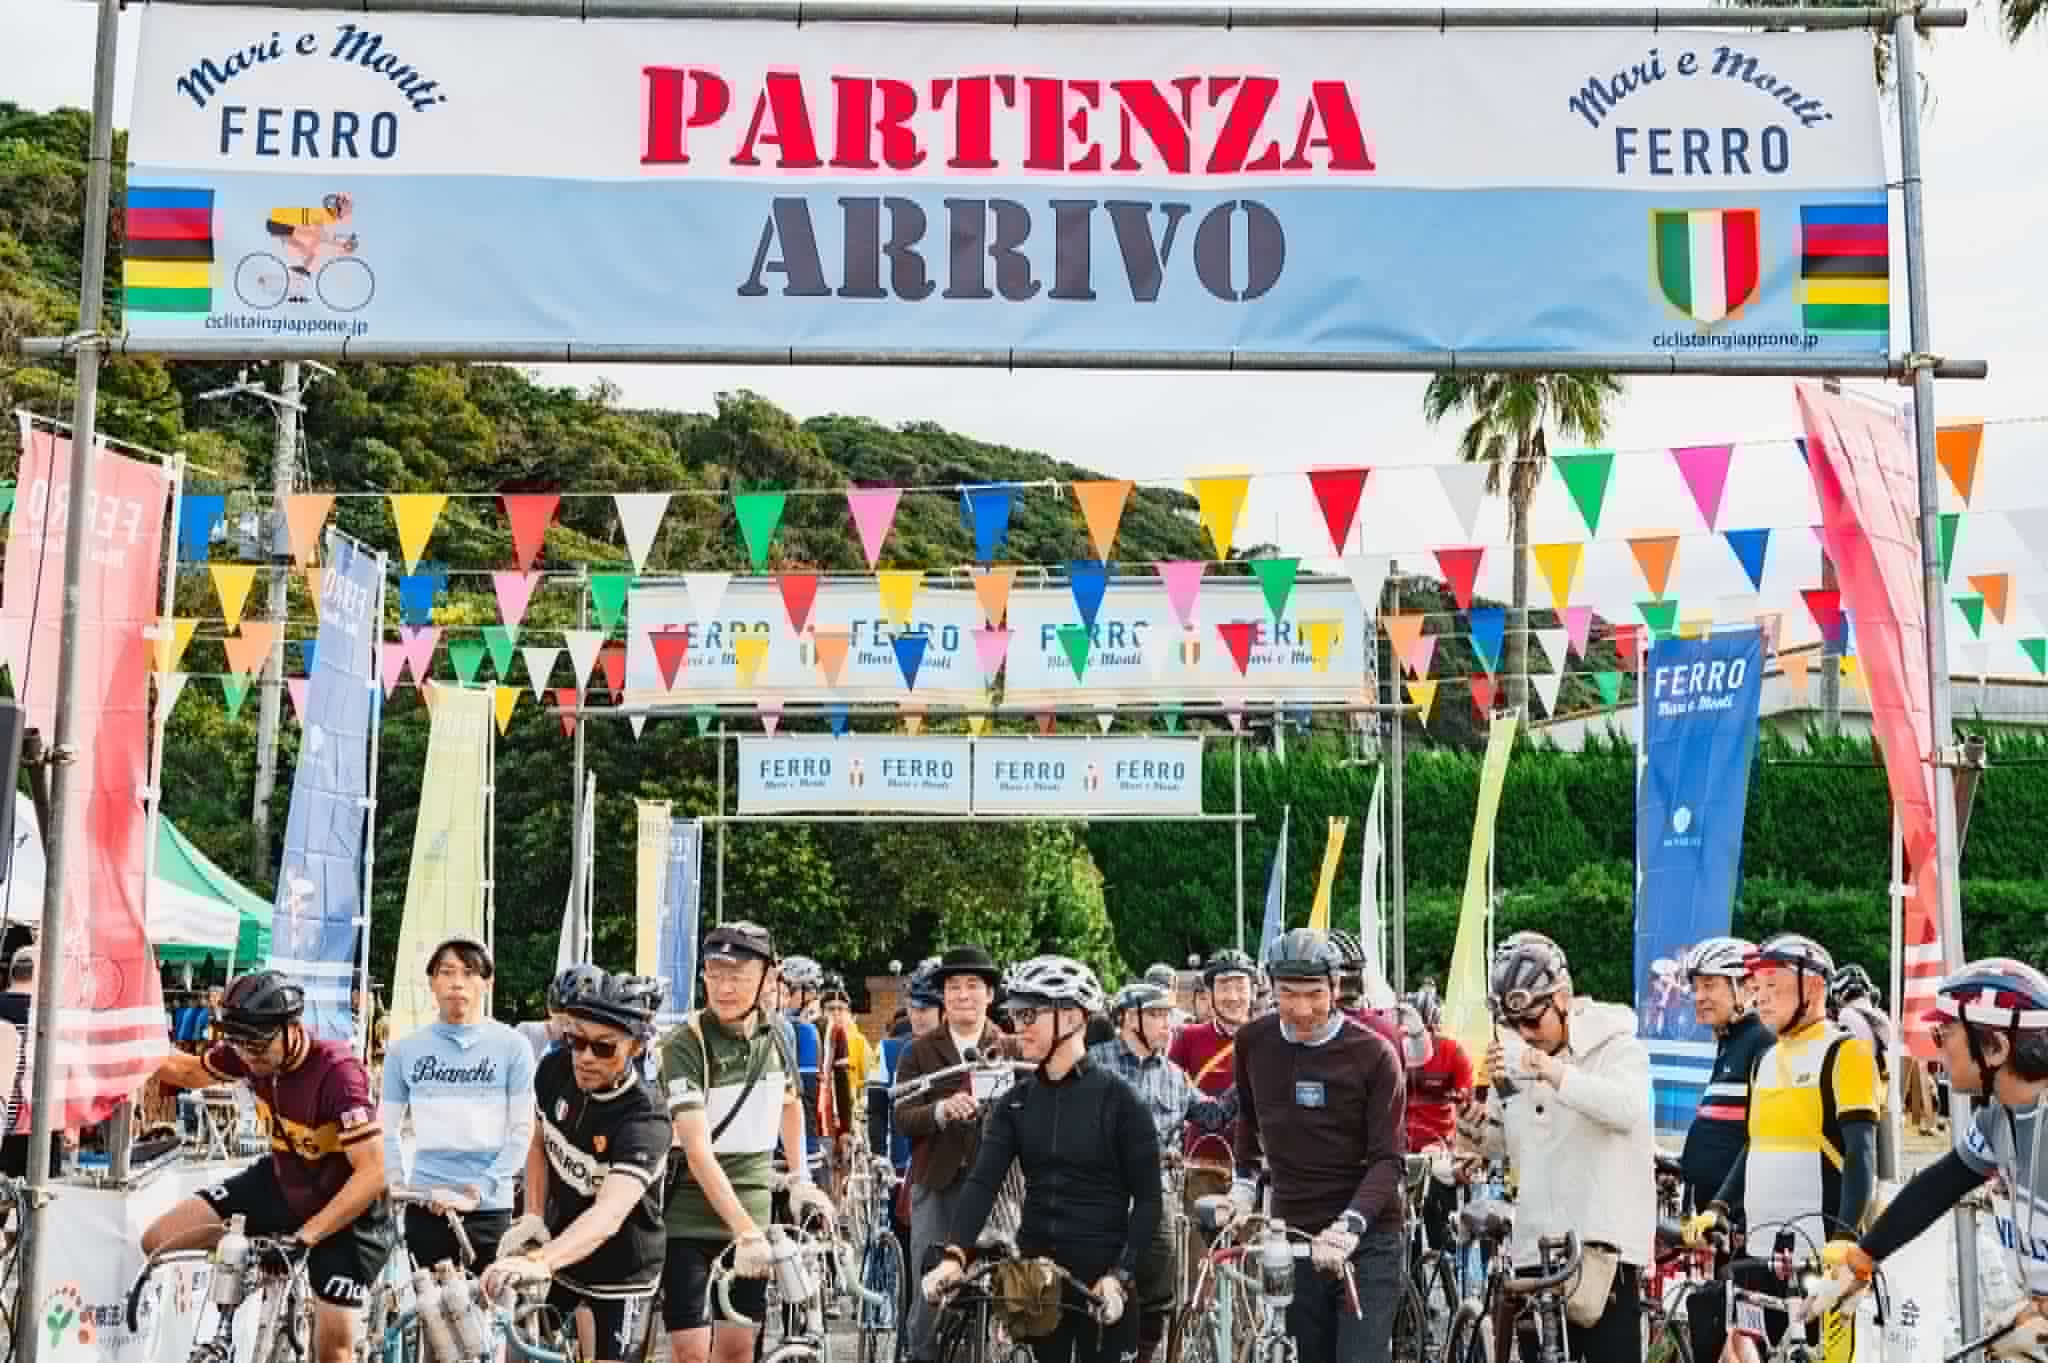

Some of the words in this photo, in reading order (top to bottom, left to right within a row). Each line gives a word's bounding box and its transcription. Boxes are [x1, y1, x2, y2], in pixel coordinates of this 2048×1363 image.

[177, 32, 282, 107] Mari
[296, 33, 317, 56] e
[330, 24, 447, 112] Monti
[1569, 48, 1665, 128] Mari
[1677, 51, 1697, 75] e
[1711, 46, 1832, 128] Monti
[220, 106, 398, 159] FERRO
[641, 66, 1376, 174] PARTENZA
[1616, 125, 1789, 175] FERRO
[736, 197, 1287, 302] ARRIVO
[205, 313, 368, 336] ciclistaingiappone.jp
[1653, 331, 1819, 351] ciclistaingiappone.jp
[1655, 659, 1746, 698] FERRO
[760, 757, 831, 778] FERRO
[883, 759, 953, 778] FERRO
[995, 761, 1065, 780] FERRO
[1116, 760, 1185, 780] FERRO
[411, 1055, 497, 1083] Bianchi
